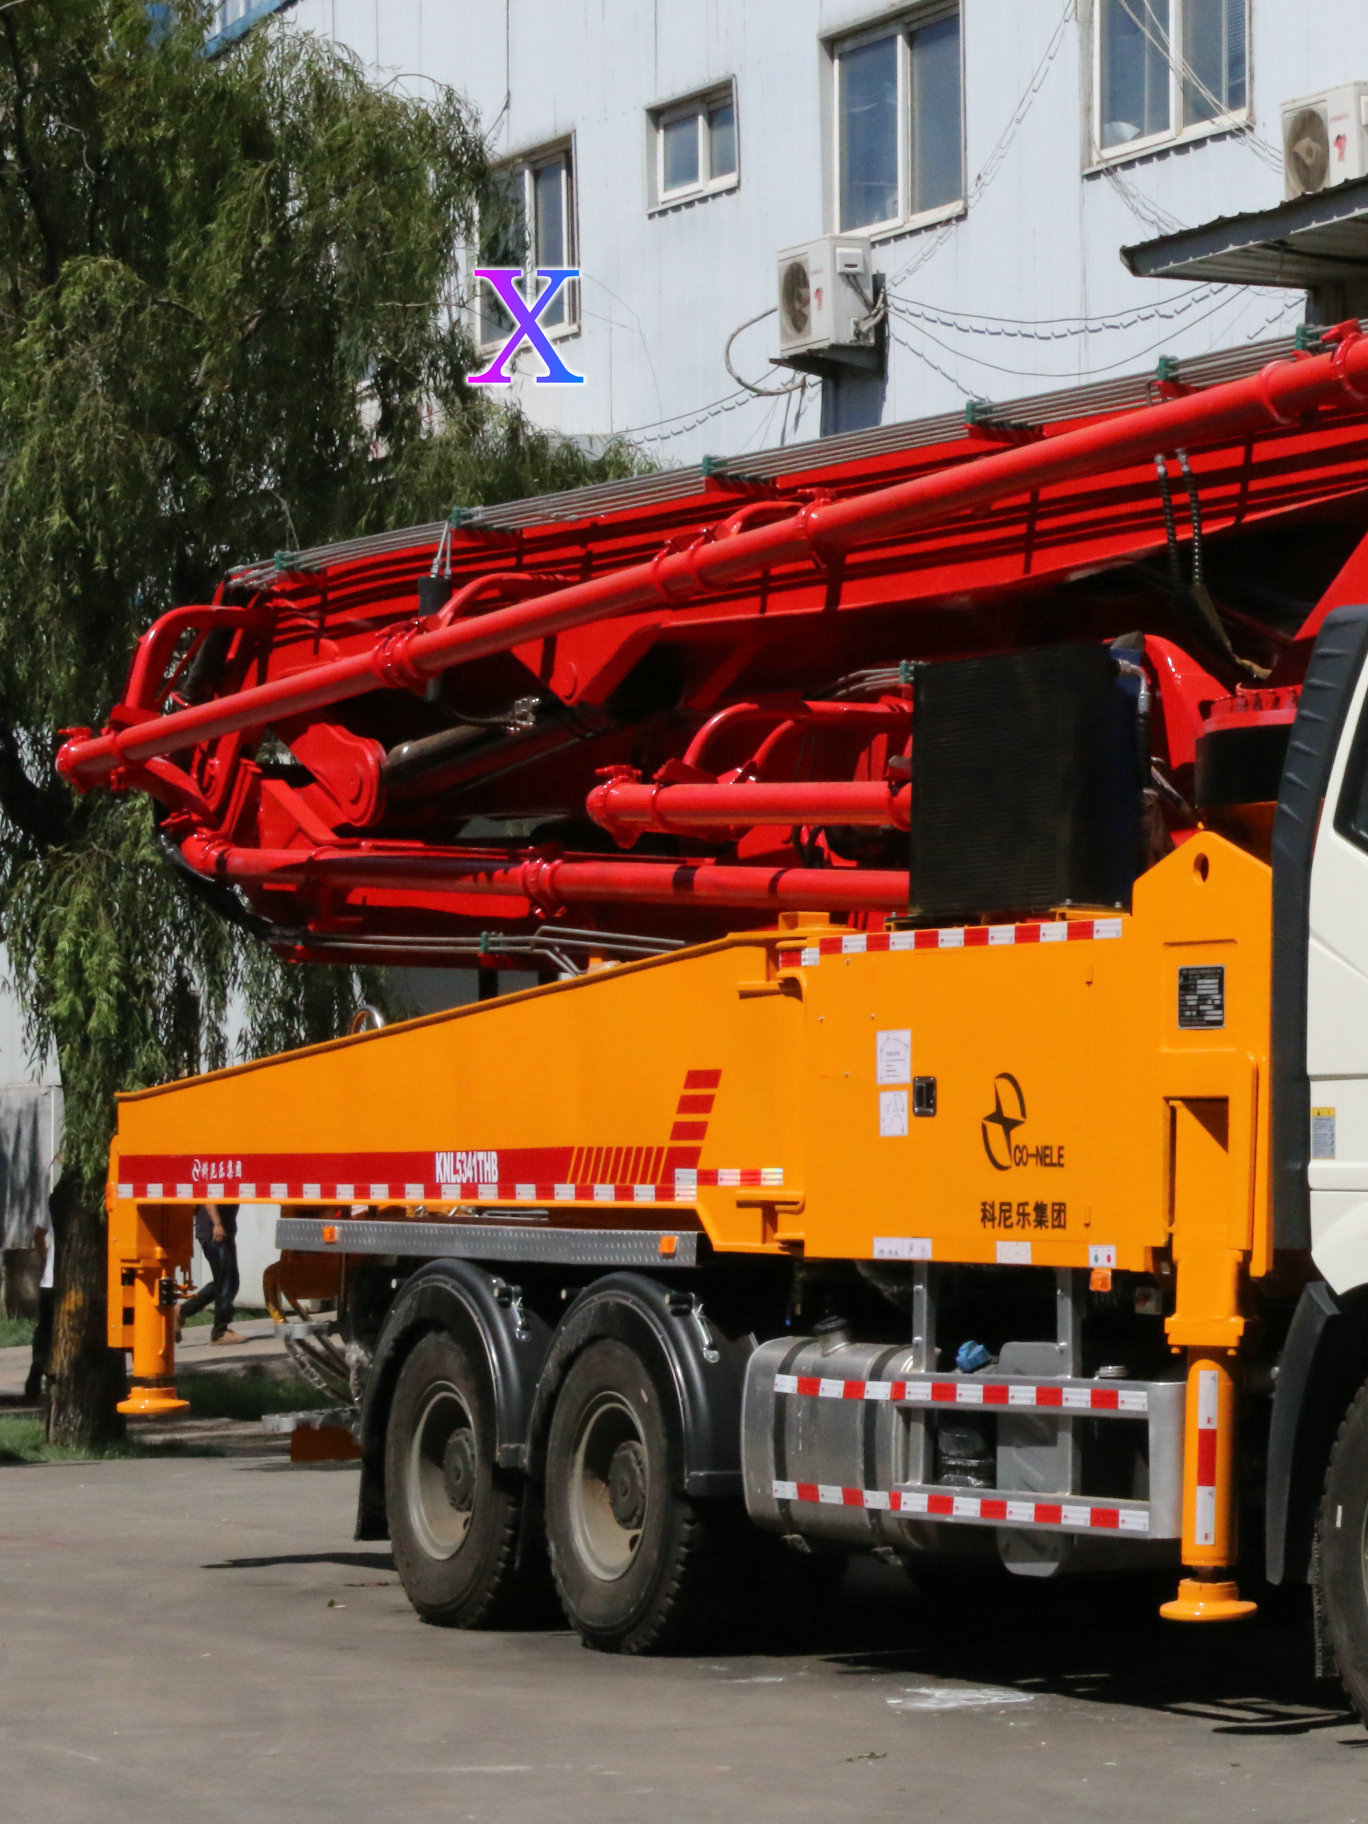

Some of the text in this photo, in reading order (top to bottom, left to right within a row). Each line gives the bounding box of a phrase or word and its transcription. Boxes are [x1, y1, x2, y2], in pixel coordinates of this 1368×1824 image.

[435, 1151, 499, 1184] KNL5341THB
[1013, 1144, 1065, 1168] CO-NELE
[980, 1200, 1067, 1229] 科尼乐集团
